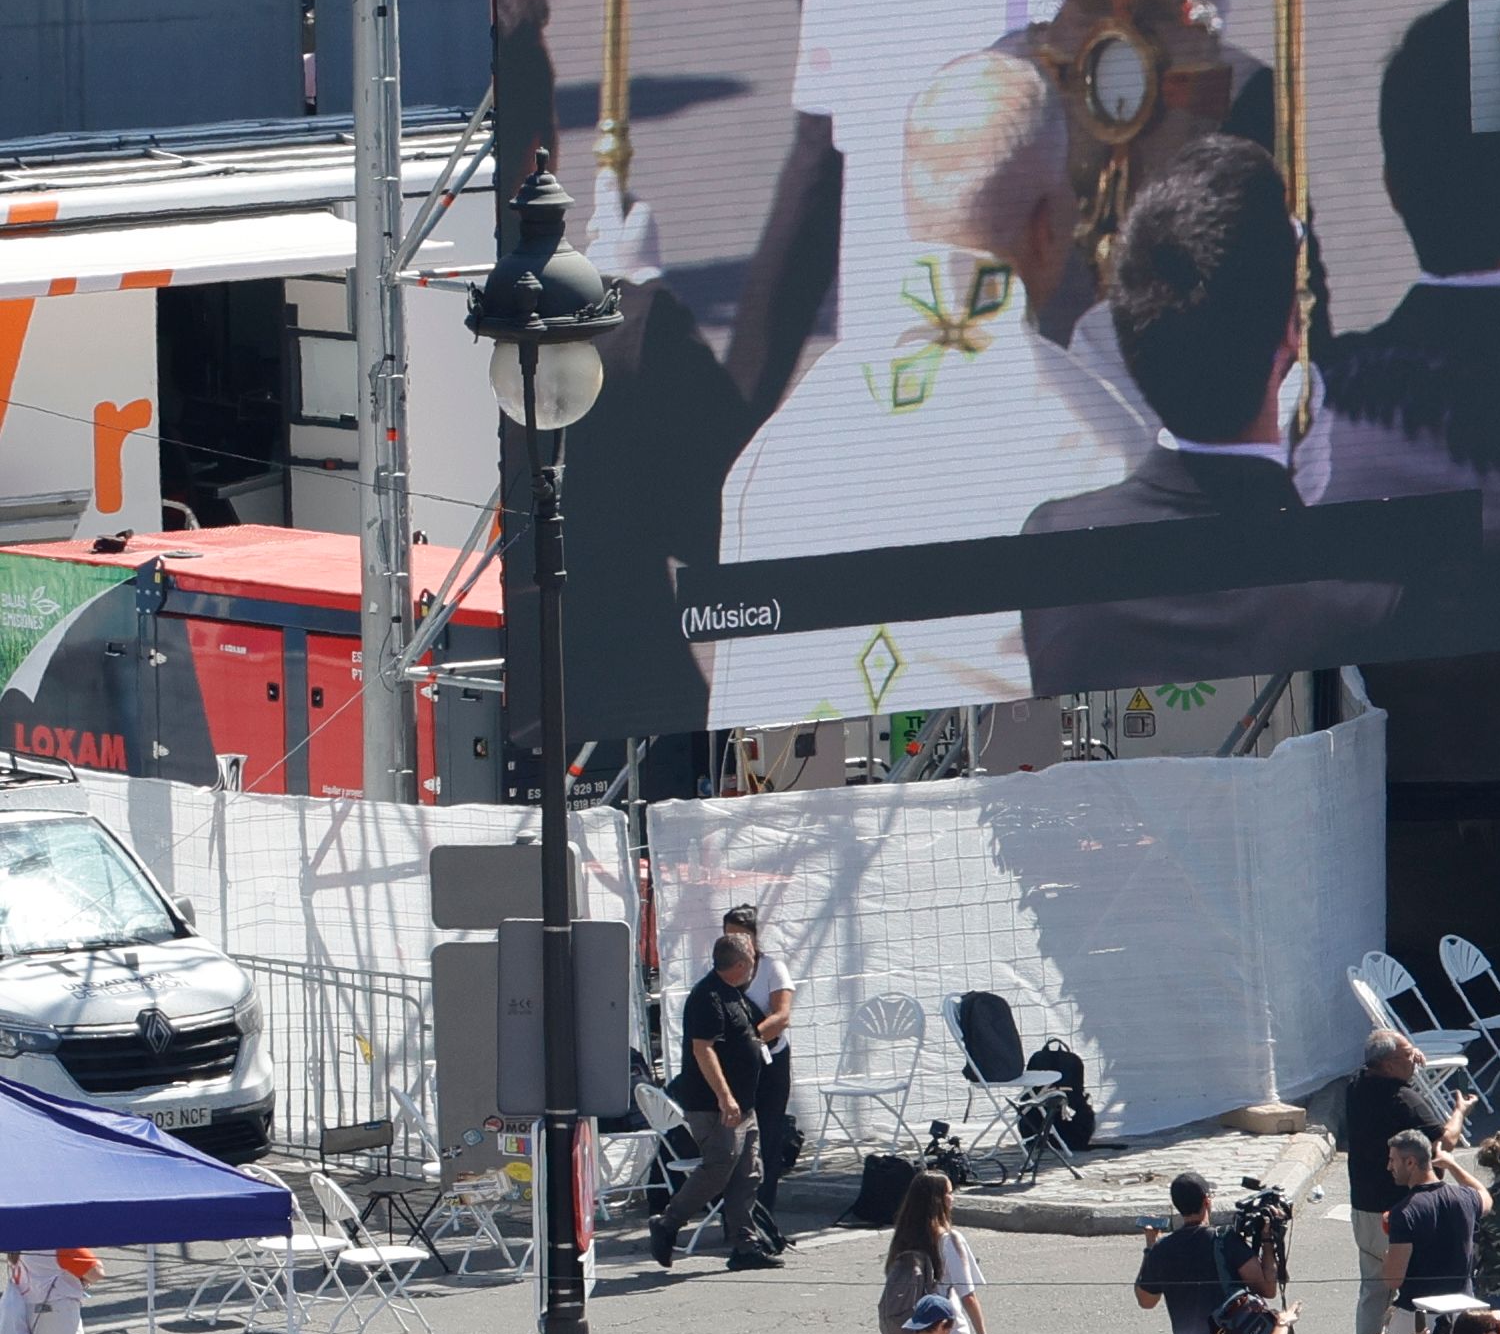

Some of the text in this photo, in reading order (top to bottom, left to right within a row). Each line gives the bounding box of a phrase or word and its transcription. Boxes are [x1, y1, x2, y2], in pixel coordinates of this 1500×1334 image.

[681, 598, 781, 639] (Música)
[14, 723, 129, 771] LOXAM
[62, 977, 127, 993] UNIDAD
[180, 1107, 210, 1125] NCF
